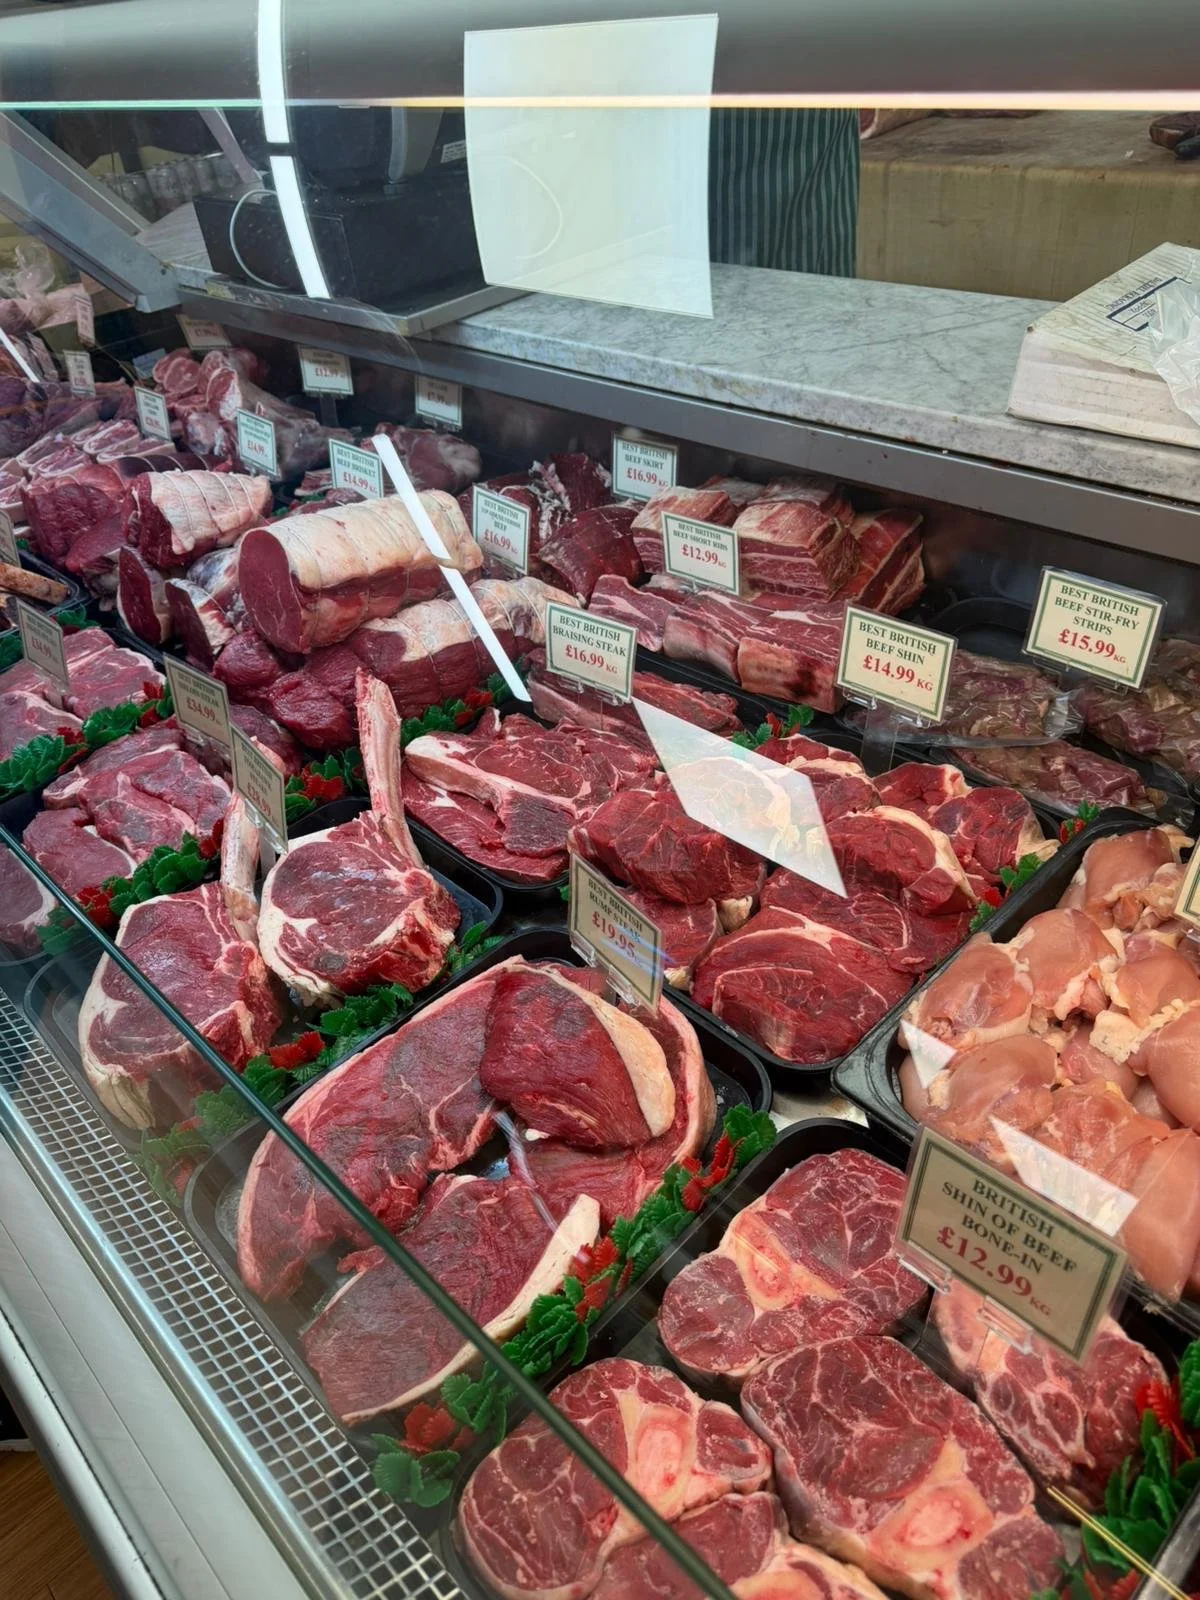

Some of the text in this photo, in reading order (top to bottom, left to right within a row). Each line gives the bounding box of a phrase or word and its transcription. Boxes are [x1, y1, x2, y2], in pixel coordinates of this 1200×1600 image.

[337, 447, 375, 468] BEST BRITISH
[622, 442, 668, 461] BEST BRITISH
[625, 453, 665, 470] BEEF SKIRT
[627, 467, 658, 485] £16.99
[484, 499, 497, 510] BEST
[497, 504, 519, 521] BRITISH
[484, 529, 511, 551] £16.99
[673, 529, 729, 552] BEEF SHORT RIBS
[678, 522, 721, 541] BEST BRITISH
[682, 543, 719, 565] £12.99
[1054, 596, 1140, 631] BEEF STIR-FRY
[1061, 585, 1140, 616] BEST BRITISH
[560, 615, 621, 642] BEST BRITISH
[859, 621, 937, 654] BEST BRITISH
[1072, 615, 1113, 636] STRIPS
[553, 625, 627, 657] BRAISING STEAK
[866, 638, 925, 665] BEEF SHIN
[1058, 628, 1116, 658] £15.99
[565, 644, 618, 674] £16.99 KG
[863, 654, 934, 692] £14.99 KG
[588, 878, 643, 931] BEST BRITISH
[590, 890, 640, 943] RUMP STEAK
[592, 911, 635, 958] £19.95
[972, 1179, 1056, 1239] BRITISH
[941, 1181, 1078, 1273] SHIN OF BEEF
[961, 1213, 1045, 1275] BONE-IN
[936, 1225, 1053, 1317] £12.99 KG
